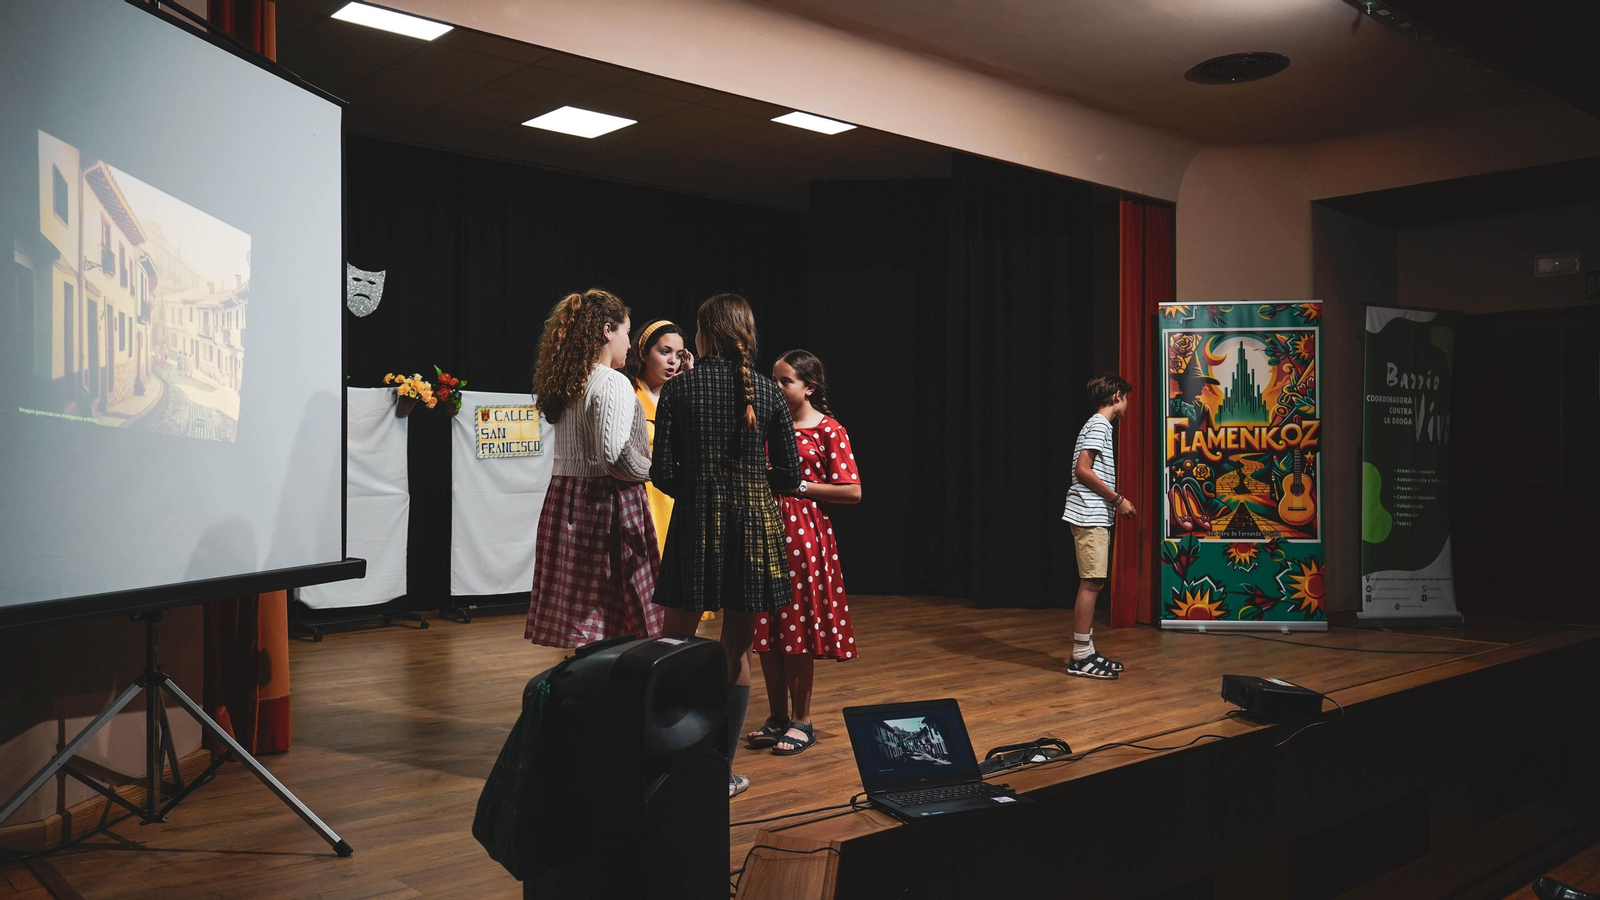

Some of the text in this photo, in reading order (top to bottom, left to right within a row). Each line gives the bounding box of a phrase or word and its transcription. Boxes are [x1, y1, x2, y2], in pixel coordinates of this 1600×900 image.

[1366, 395, 1412, 404] COORDINADORA
[494, 410, 534, 421] CALLE
[1389, 407, 1412, 415] CONTRA
[481, 428, 506, 439] SAN
[1166, 417, 1321, 462] FLAMENKOZ
[481, 441, 540, 454] FRANCISCO
